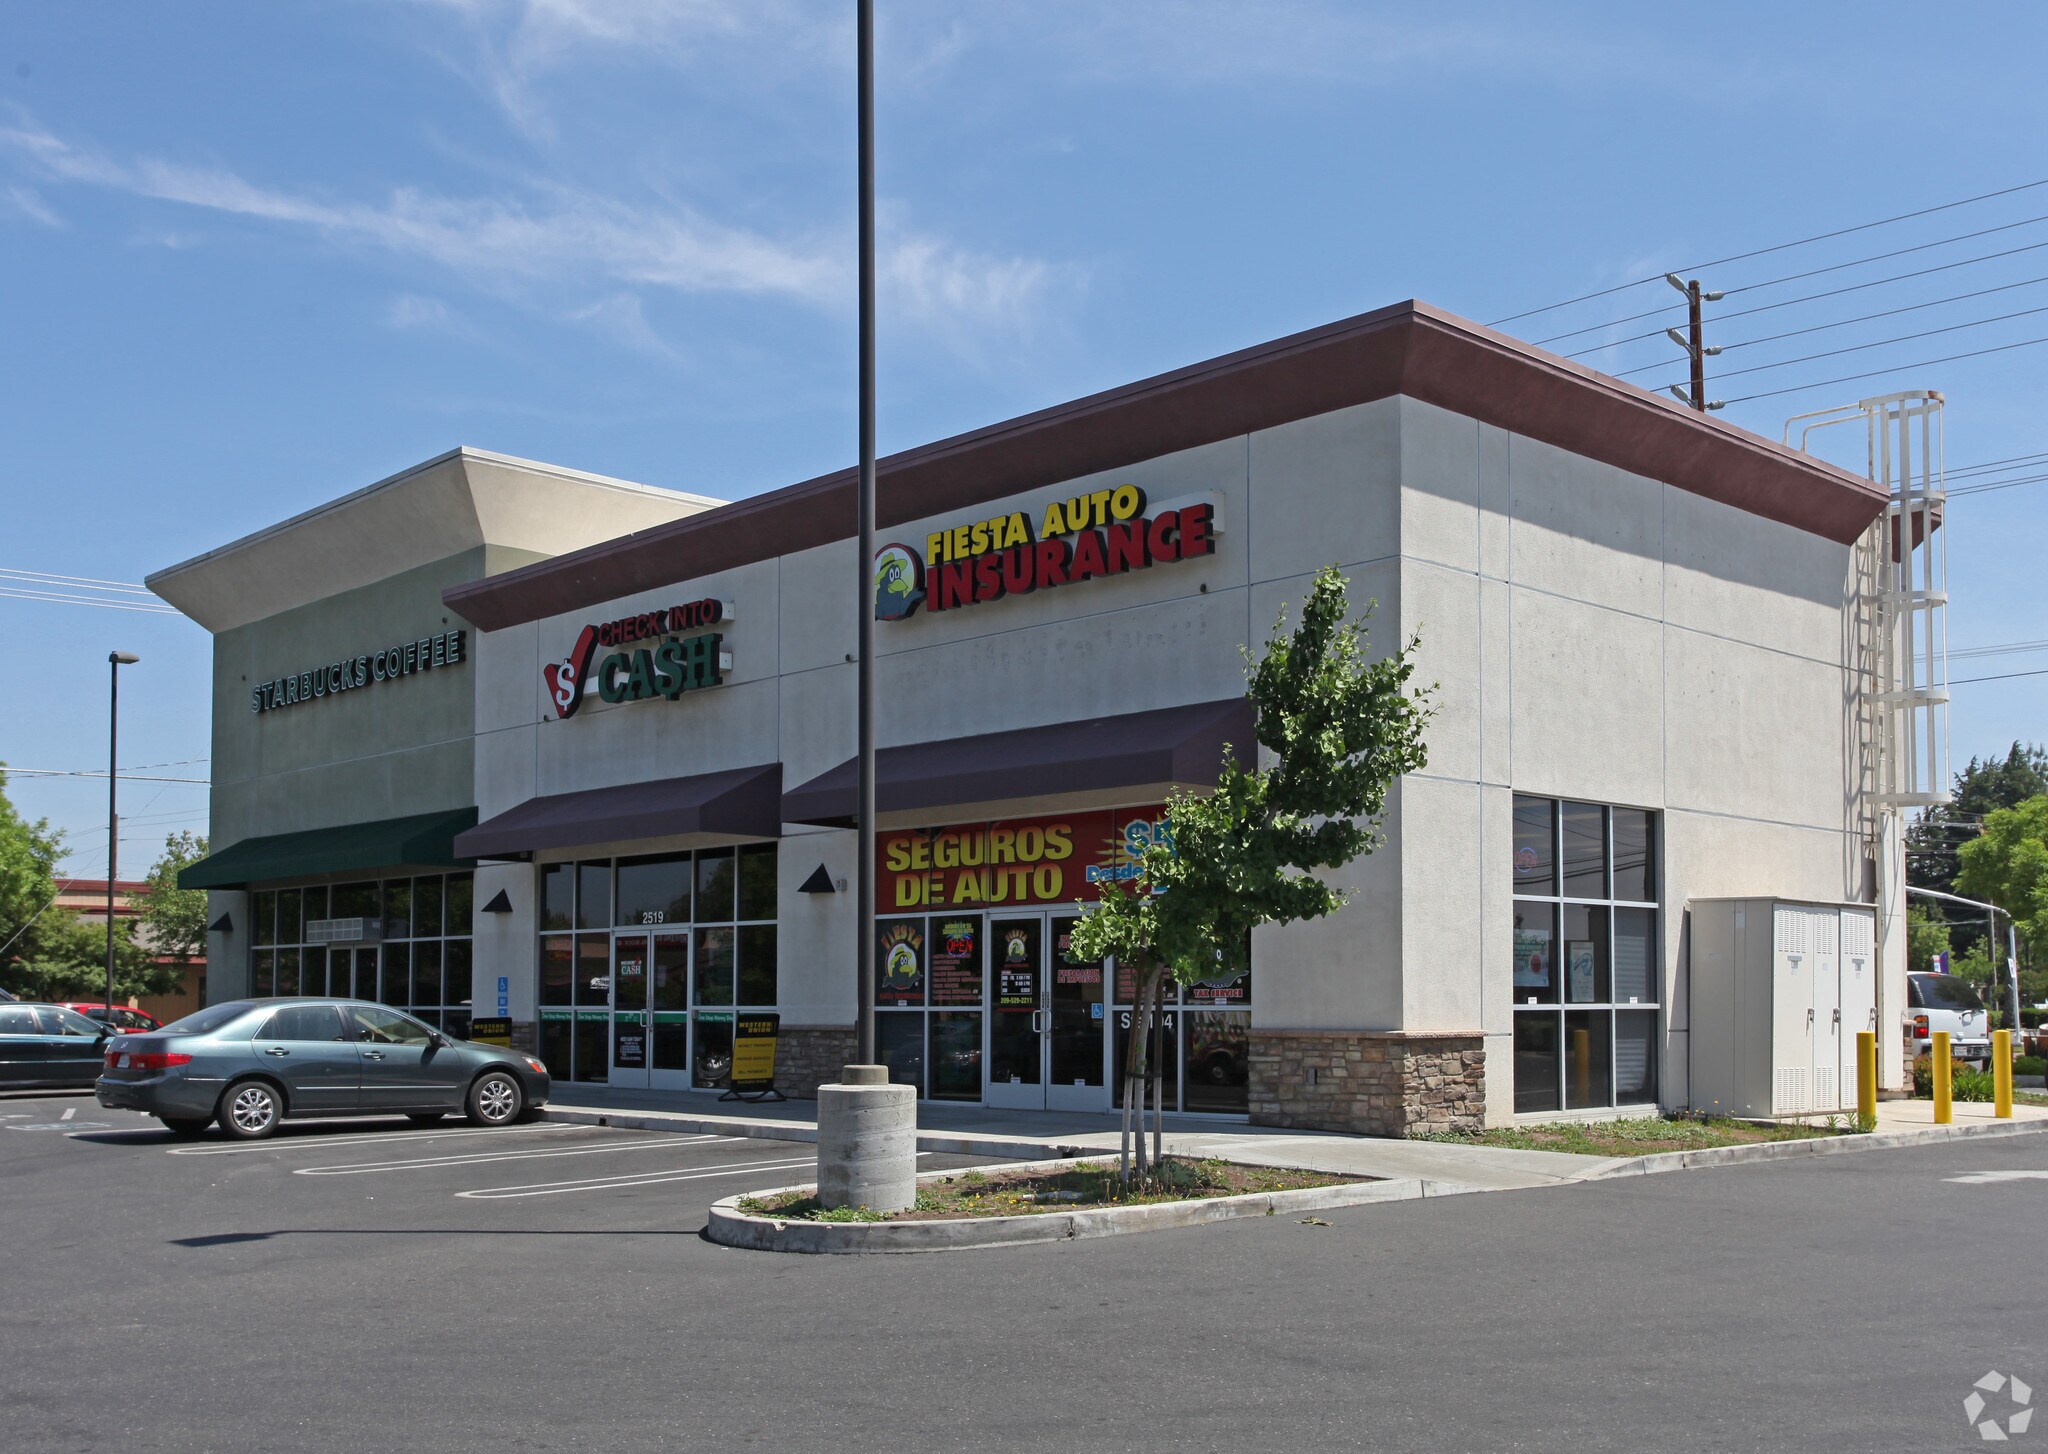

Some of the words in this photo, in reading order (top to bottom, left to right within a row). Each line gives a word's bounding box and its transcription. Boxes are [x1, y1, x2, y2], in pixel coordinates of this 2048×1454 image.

[927, 511, 1035, 566] FIESTA
[1040, 484, 1146, 539] AUTO
[927, 503, 1215, 612] INSURANCE
[599, 609, 665, 646] CHECK
[667, 598, 723, 633] INTO
[251, 655, 368, 713] STARBUCKS
[371, 629, 466, 682] COFFEE
[886, 822, 1074, 871] SEGUROS
[895, 872, 946, 907] DE
[952, 864, 1064, 904] AUTO
[1086, 861, 1145, 882] Desde
[642, 911, 664, 924] 2519
[946, 939, 973, 953] OPEN
[1193, 988, 1210, 998] TAX
[1211, 988, 1243, 998] SERVICE
